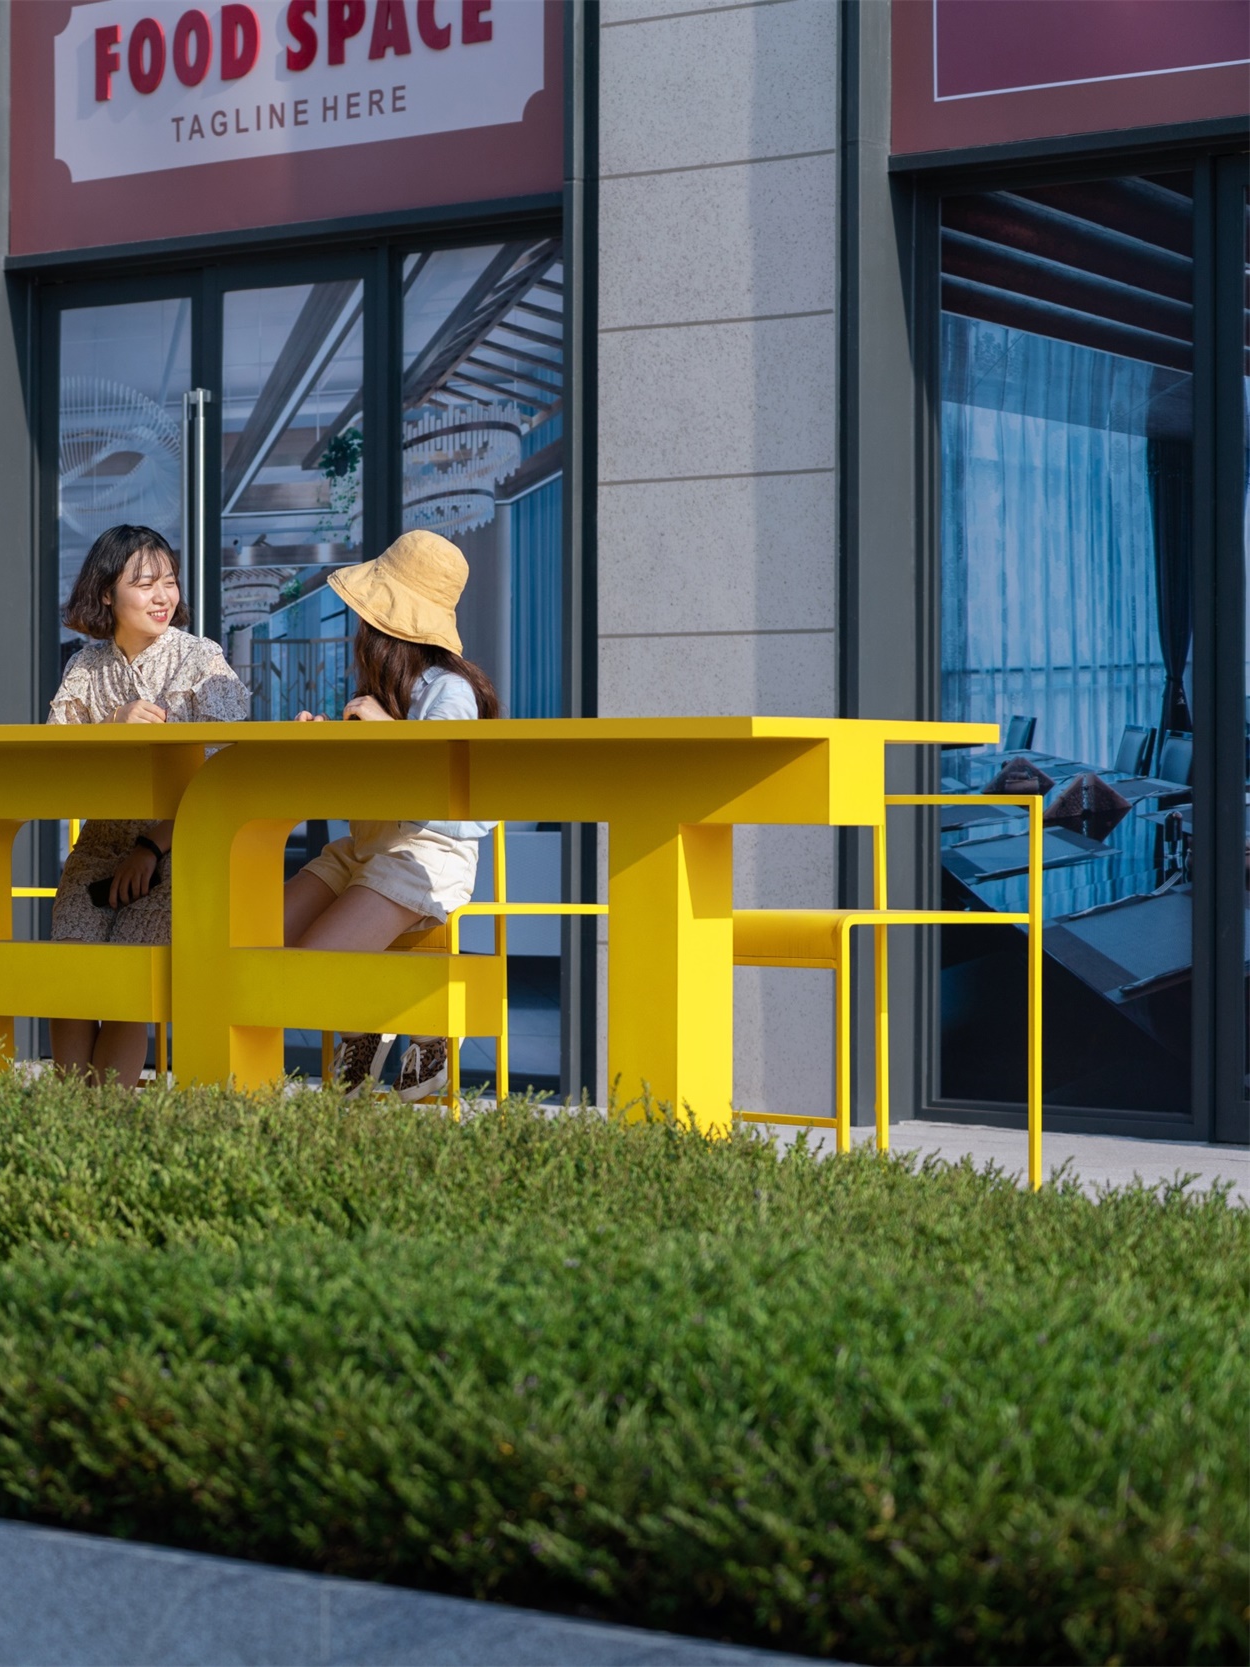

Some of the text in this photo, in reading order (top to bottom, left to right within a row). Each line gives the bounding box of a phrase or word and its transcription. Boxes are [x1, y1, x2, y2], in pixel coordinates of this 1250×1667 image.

[94, 0, 493, 102] FOOD SPACE
[171, 85, 407, 143] TAGLINE HERE
